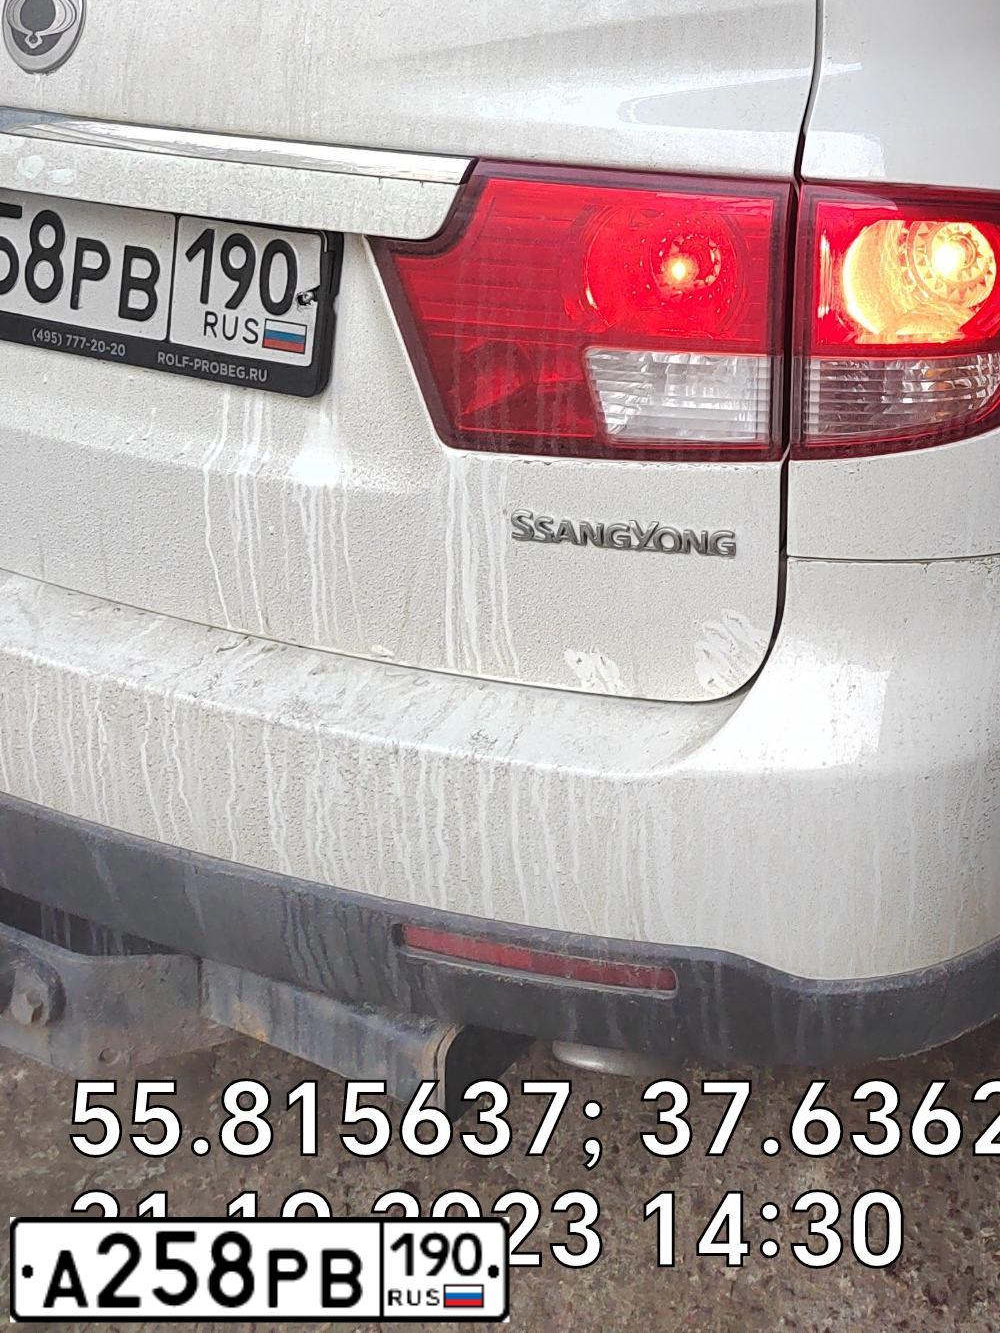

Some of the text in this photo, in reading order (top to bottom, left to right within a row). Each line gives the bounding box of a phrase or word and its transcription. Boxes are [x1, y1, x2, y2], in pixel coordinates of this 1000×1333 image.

[185, 228, 298, 316] 190
[31, 327, 268, 383] (495) 777-20-20 ROLF-PROBEG.RU
[203, 311, 260, 345] RUS
